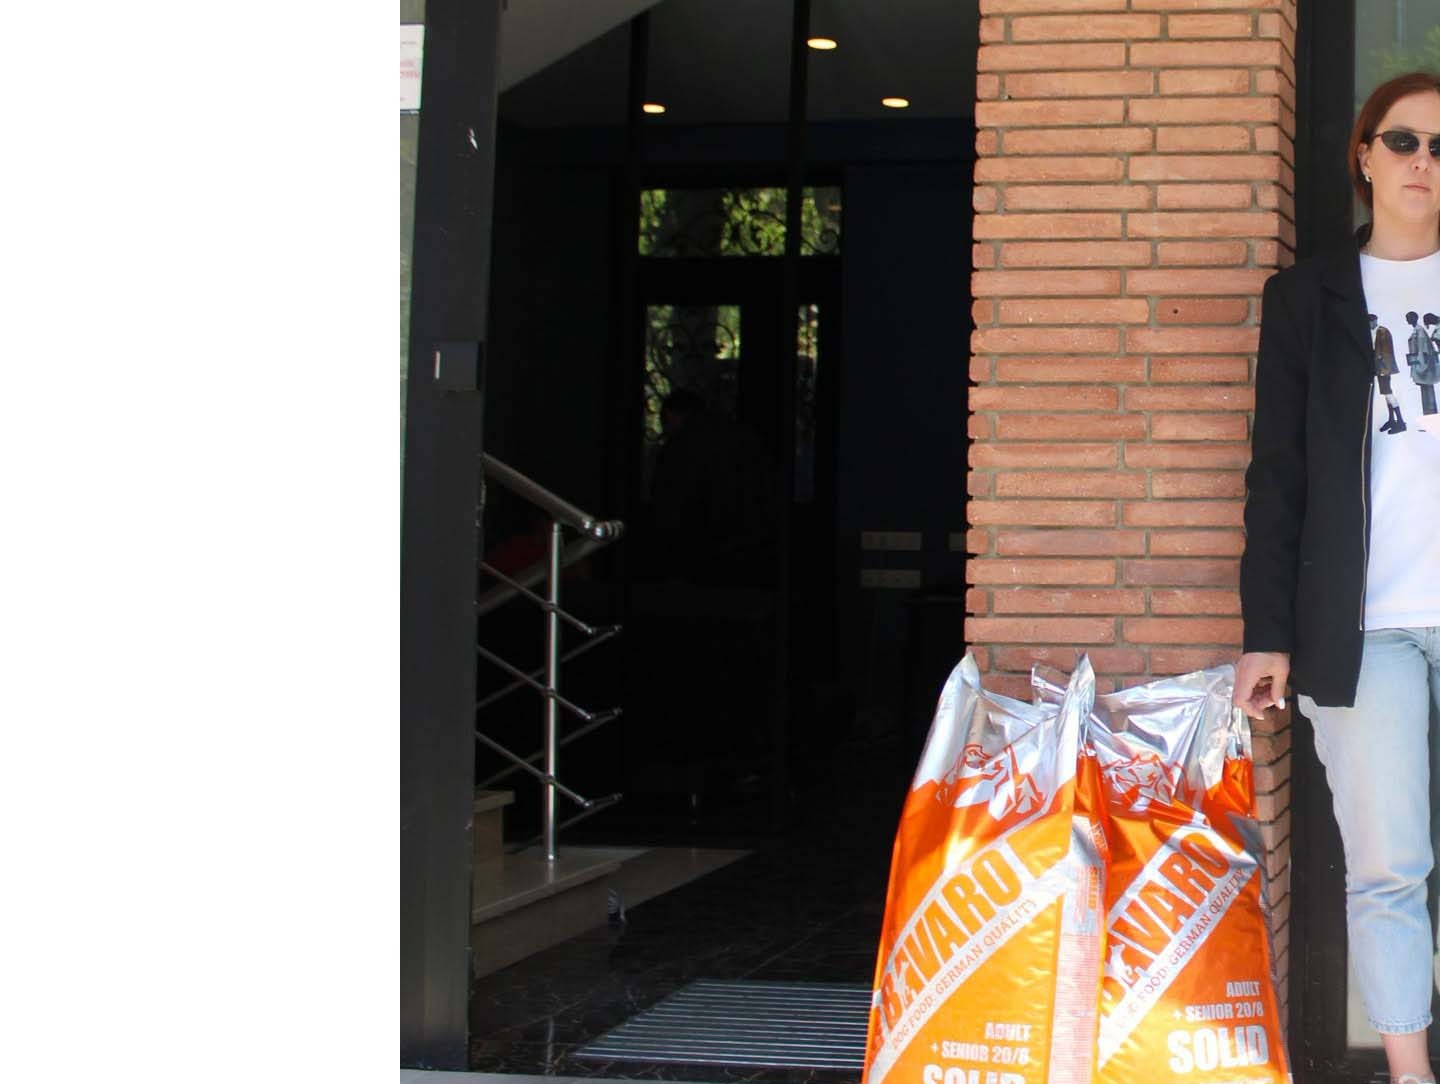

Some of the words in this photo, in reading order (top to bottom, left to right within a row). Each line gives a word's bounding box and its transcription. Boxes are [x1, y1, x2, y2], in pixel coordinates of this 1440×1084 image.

[1168, 914, 1211, 966] GERMAN
[1208, 868, 1247, 915] QUALITY
[935, 944, 983, 995] GERMAN
[983, 899, 1038, 947] QUALITY
[1226, 981, 1261, 998] ADULT
[1185, 1003, 1234, 1023] SENIOR
[1235, 1001, 1265, 1019] 20/8
[984, 1021, 1032, 1041] ADULT
[941, 1040, 989, 1062] SENIOR
[1167, 1024, 1269, 1074] SOLID
